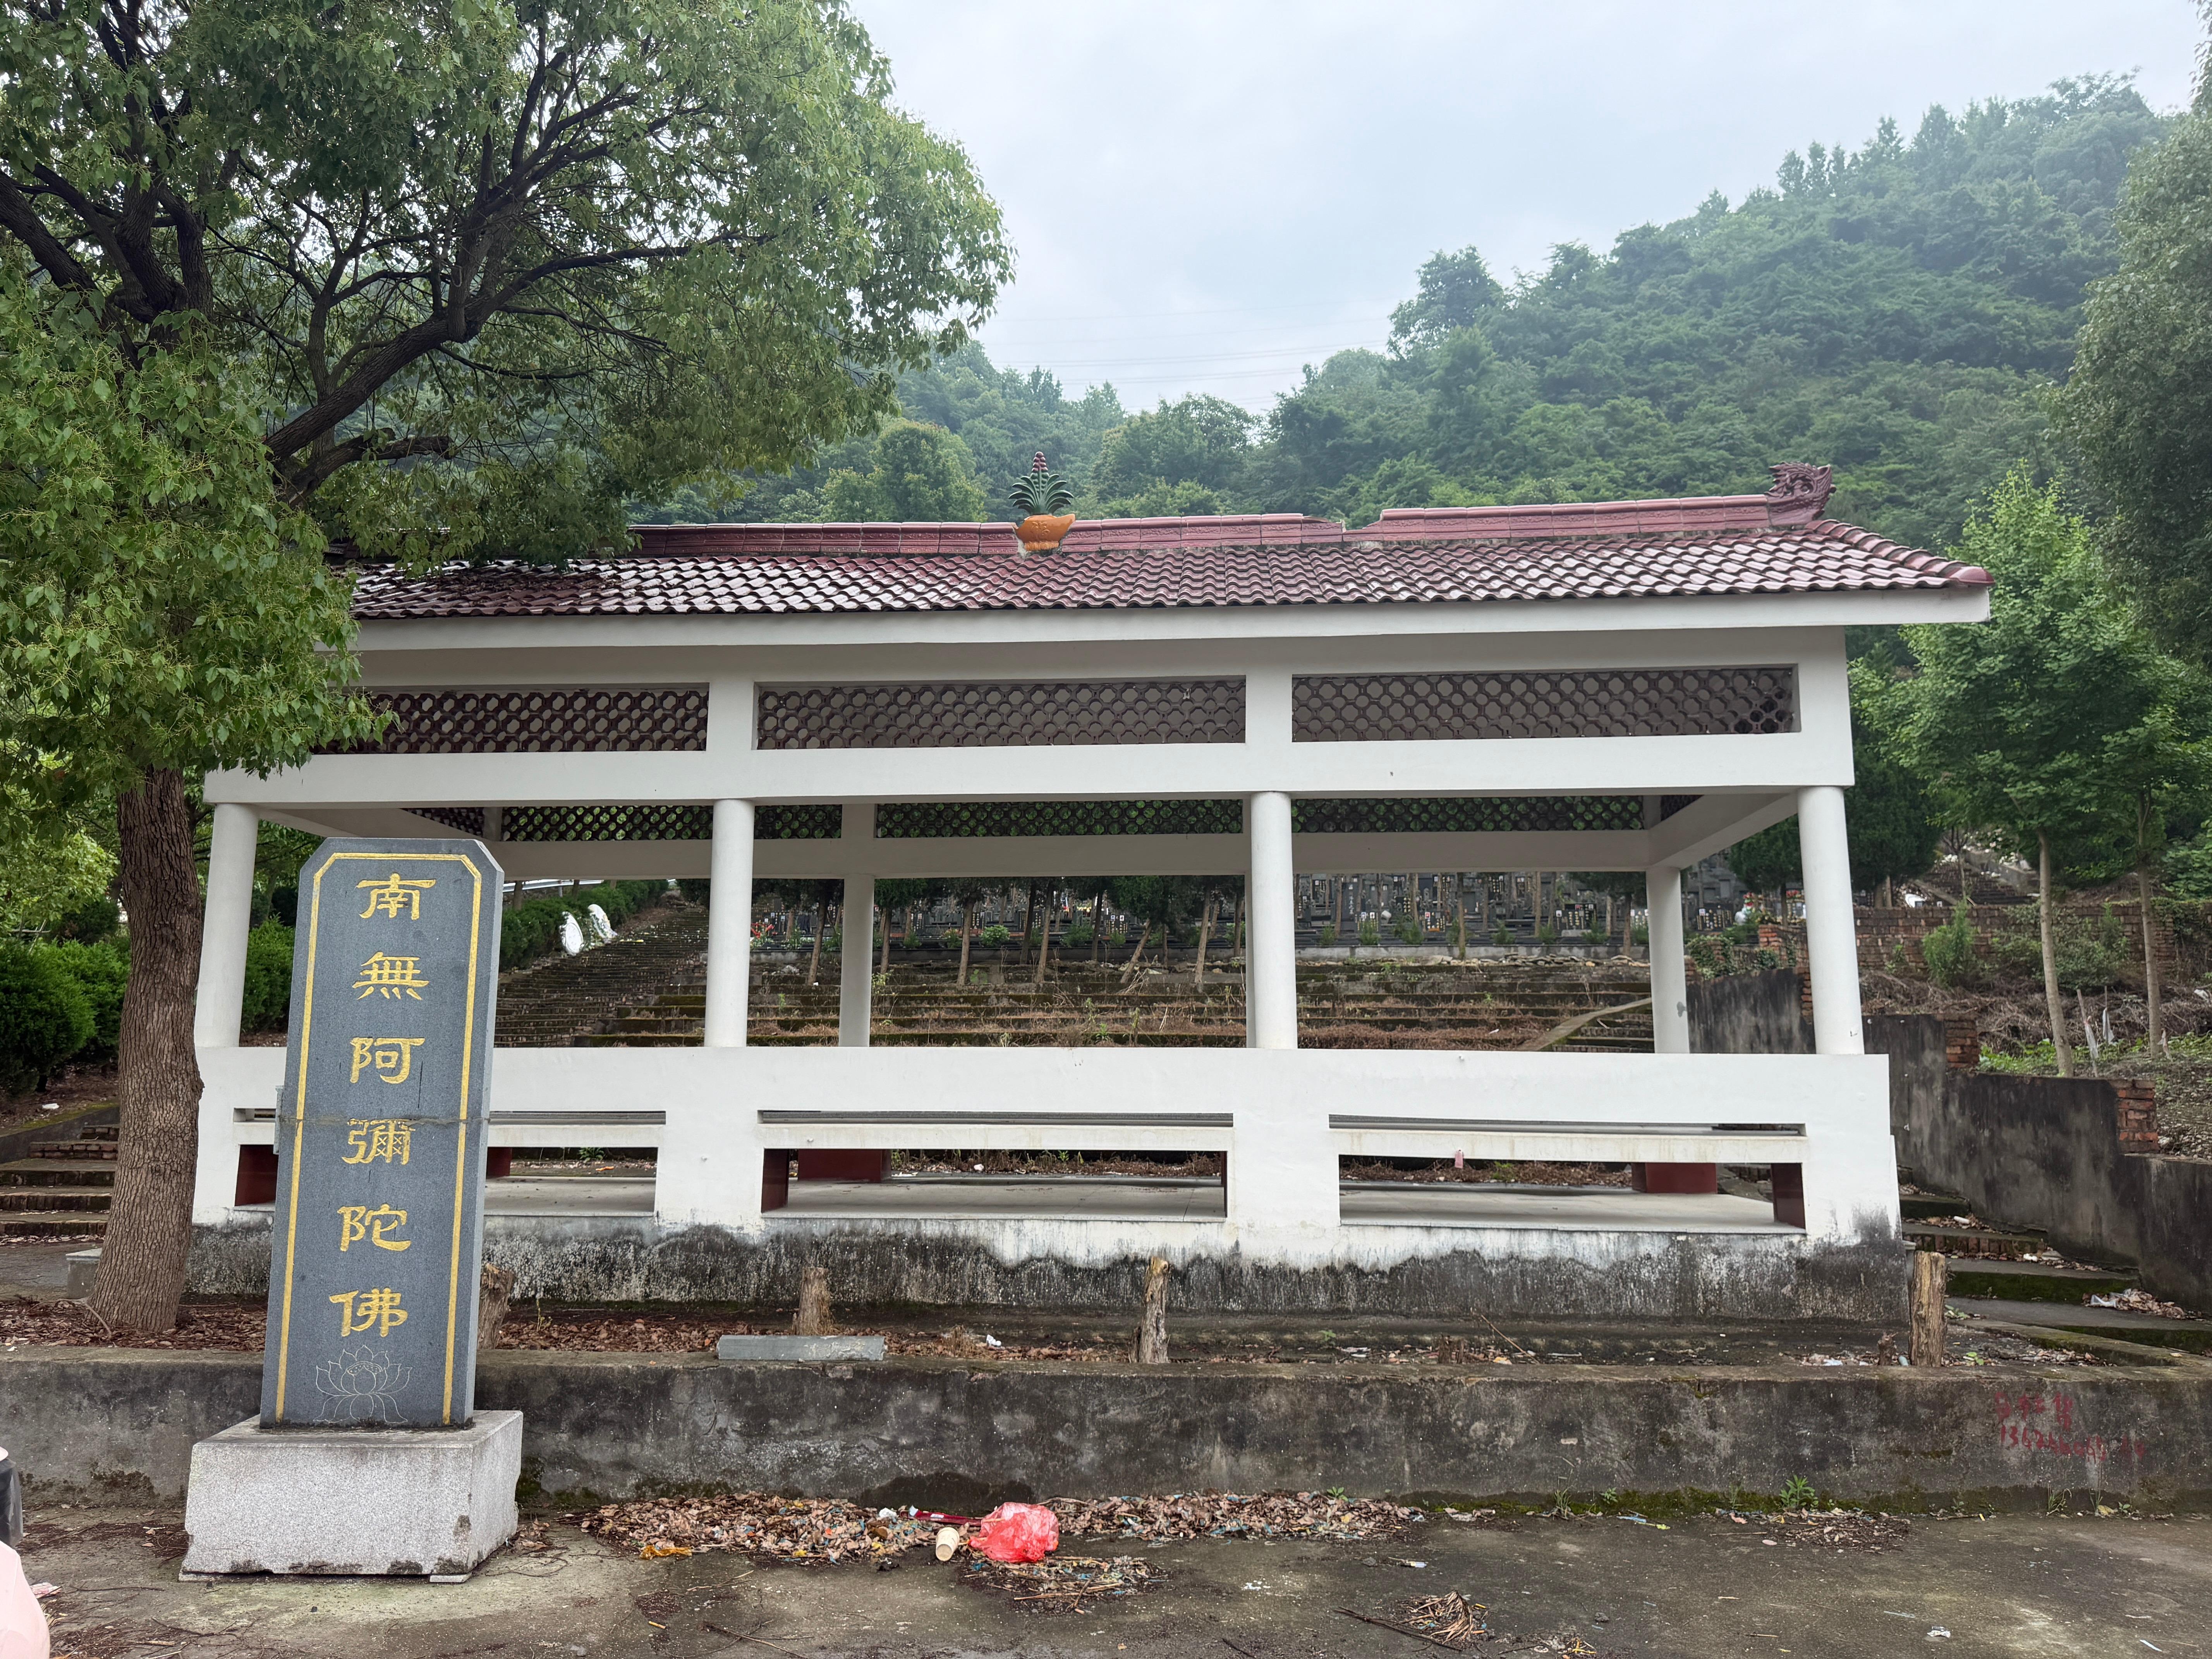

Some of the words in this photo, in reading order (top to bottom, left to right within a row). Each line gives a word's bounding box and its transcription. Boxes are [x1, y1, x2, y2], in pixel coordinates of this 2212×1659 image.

[329, 872, 436, 1338] 南無阿彌陀佛
